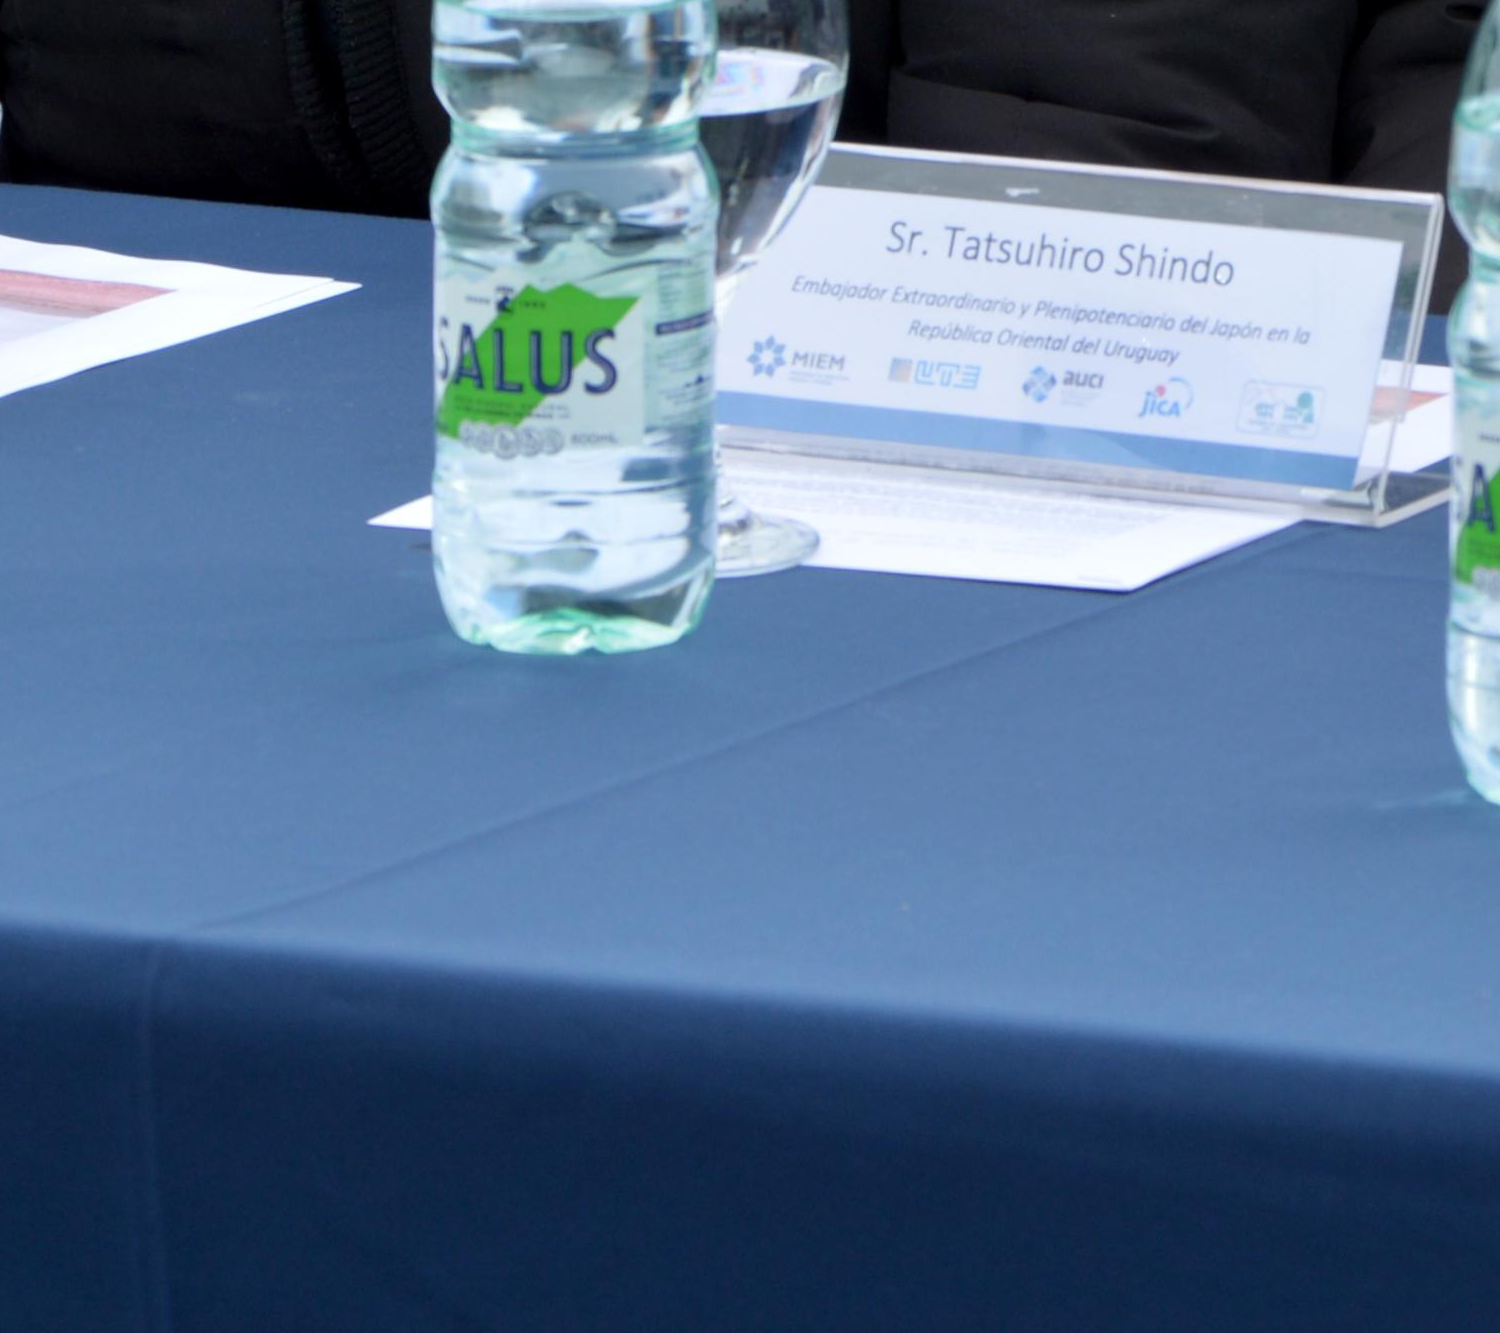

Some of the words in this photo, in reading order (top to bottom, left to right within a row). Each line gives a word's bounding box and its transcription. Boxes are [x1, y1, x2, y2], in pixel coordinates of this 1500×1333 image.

[886, 221, 928, 257] Sr.
[945, 226, 1104, 273] Tatsuhiro
[1114, 243, 1235, 286] Shindo
[791, 275, 887, 302] Embajador
[891, 285, 1016, 315] Extraordinario
[1019, 303, 1030, 319] y
[1034, 299, 1176, 331] Plenipotenciario
[1180, 314, 1208, 333] del
[1210, 318, 1262, 339] Japón
[1267, 328, 1290, 342] en
[1292, 326, 1311, 345] la
[791, 350, 845, 372] MIEM
[908, 319, 992, 345] República
[997, 330, 1068, 353] Oriental
[1071, 334, 1100, 355] del
[1103, 337, 1180, 366] Uruguay
